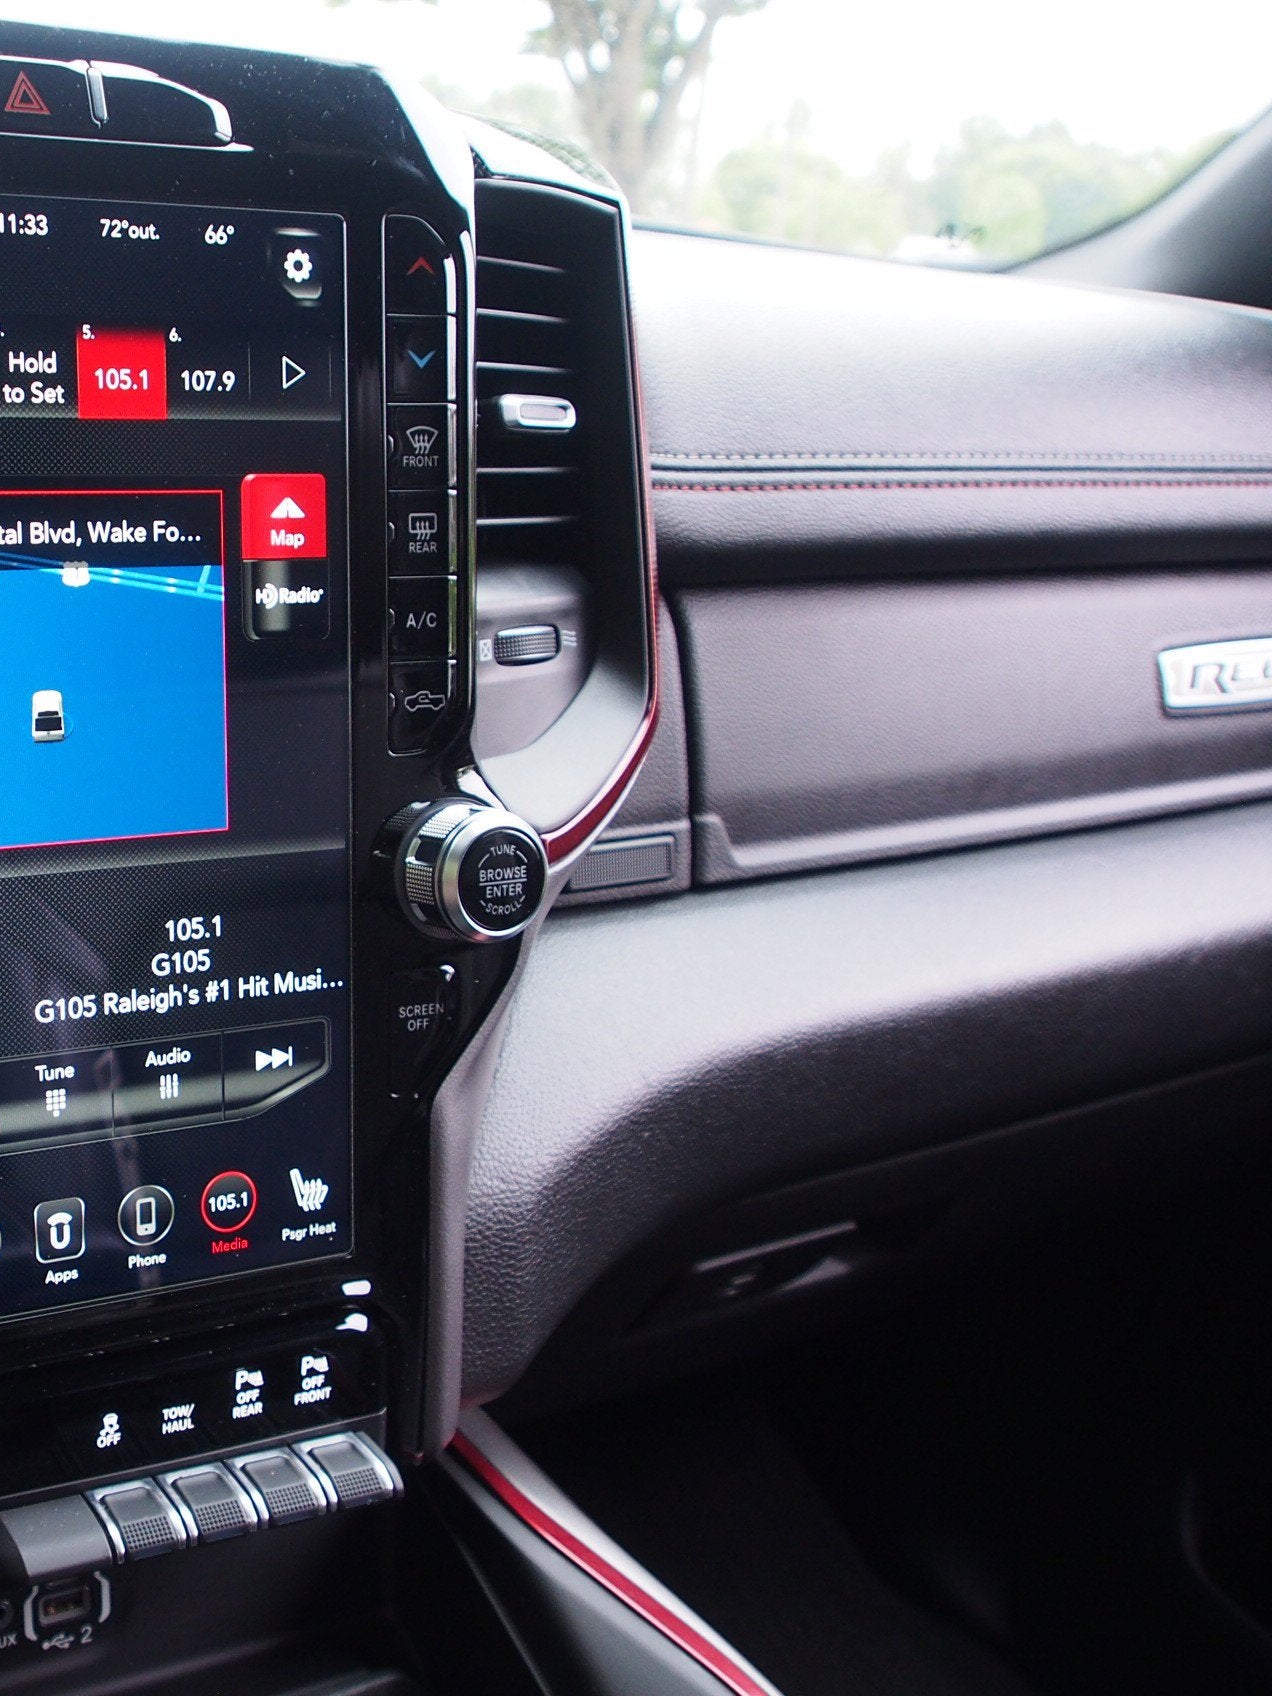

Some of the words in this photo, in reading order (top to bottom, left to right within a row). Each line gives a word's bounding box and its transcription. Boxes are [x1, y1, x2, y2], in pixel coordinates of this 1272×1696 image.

[7, 350, 57, 375] Hold
[94, 367, 149, 391] 105.1
[181, 369, 236, 393] 107.9
[2, 383, 24, 403] to
[30, 381, 65, 405] Set
[403, 455, 439, 468] FRONT
[30, 520, 82, 547] Blvd,
[87, 519, 147, 543] Wake
[270, 530, 305, 548] Map
[409, 541, 438, 553] REAR
[406, 612, 438, 629] A/C
[491, 844, 516, 856] TUNE
[479, 865, 527, 882] BROWSE
[486, 883, 523, 899] ENTER
[486, 900, 521, 916] SCROLL
[164, 915, 222, 942] 105.1
[151, 949, 211, 976] G105
[34, 995, 97, 1023] G105
[102, 984, 199, 1014] Raleigh's
[205, 980, 230, 1003] #1
[238, 975, 269, 998] Hit
[399, 1003, 445, 1019] SCREEN
[408, 1019, 429, 1032] OFF
[145, 1047, 191, 1068] Audio
[35, 1064, 75, 1082] Tune
[209, 1191, 249, 1213] 105.1
[281, 1226, 307, 1243] Psgr
[309, 1221, 337, 1237] Heat
[212, 1237, 249, 1254] Media
[128, 1251, 167, 1270] Phone
[45, 1268, 79, 1285] Apps
[301, 1374, 325, 1390] OFF
[236, 1389, 260, 1404] OFF
[294, 1386, 331, 1405] FRONT
[232, 1402, 263, 1419] REAR
[162, 1417, 194, 1434] HAUL
[96, 1433, 121, 1448] OFF
[81, 1626, 93, 1643] 2
